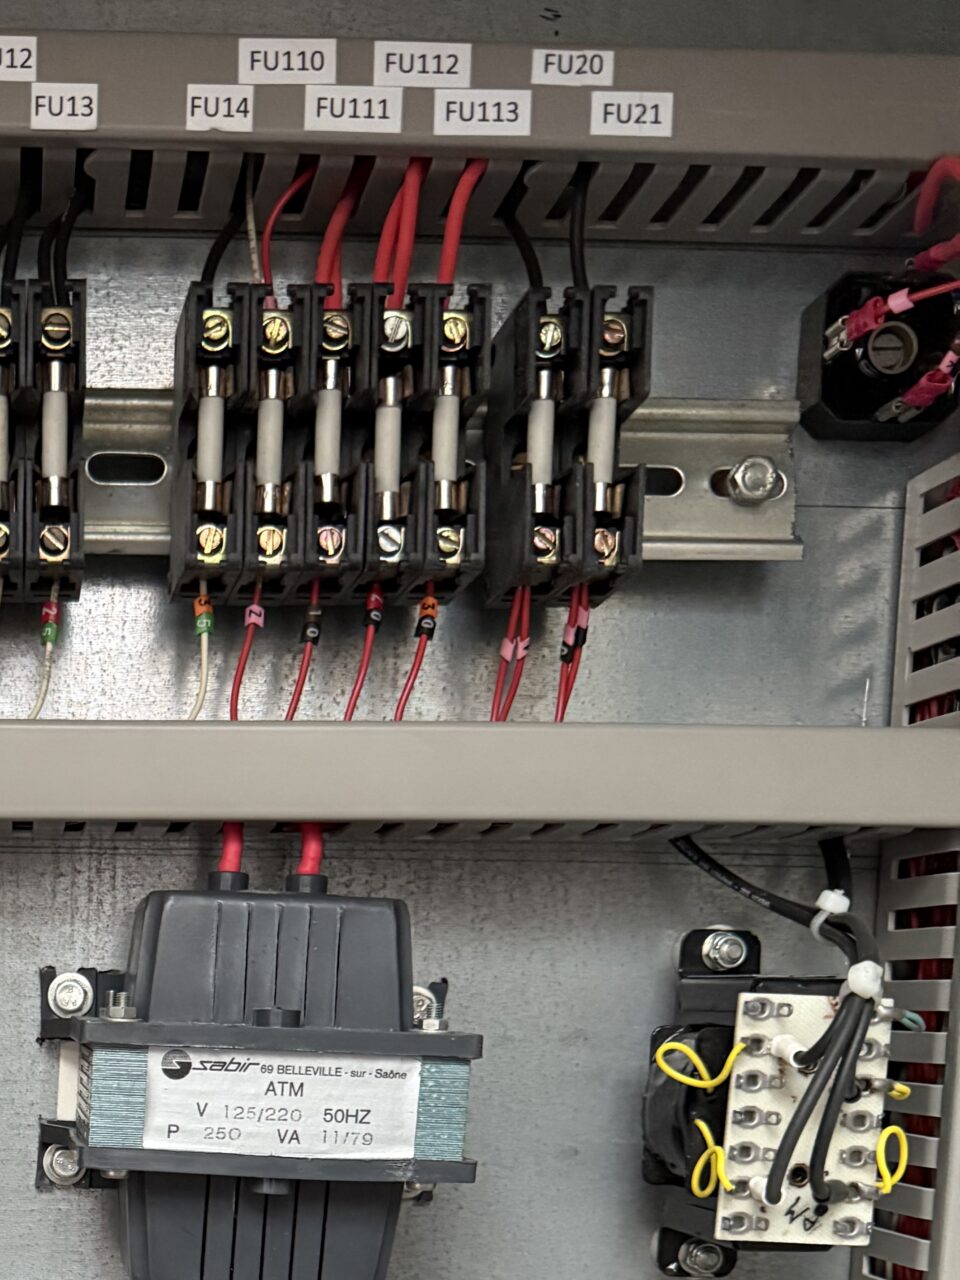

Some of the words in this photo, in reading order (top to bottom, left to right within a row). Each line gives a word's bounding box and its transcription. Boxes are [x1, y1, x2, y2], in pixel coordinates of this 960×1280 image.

[249, 50, 325, 71] FU110
[385, 53, 459, 75] FU112
[543, 53, 604, 75] FU20
[35, 96, 94, 117] FU13
[190, 96, 250, 118] FU14
[316, 98, 390, 119] FU111
[445, 101, 520, 123] FU113
[602, 102, 663, 125] FU21
[192, 1057, 260, 1073] sabir
[260, 1065, 274, 1075] 69
[276, 1065, 342, 1077] BELLEVILLE
[374, 1068, 408, 1080] Saône
[264, 1081, 304, 1097] ATM
[196, 1102, 208, 1117] V
[223, 1104, 303, 1122] 125/220
[323, 1109, 372, 1125] 50HZ
[168, 1124, 180, 1138] P
[203, 1127, 241, 1140] 250
[277, 1129, 301, 1145] VA
[322, 1131, 374, 1146] 11/79
